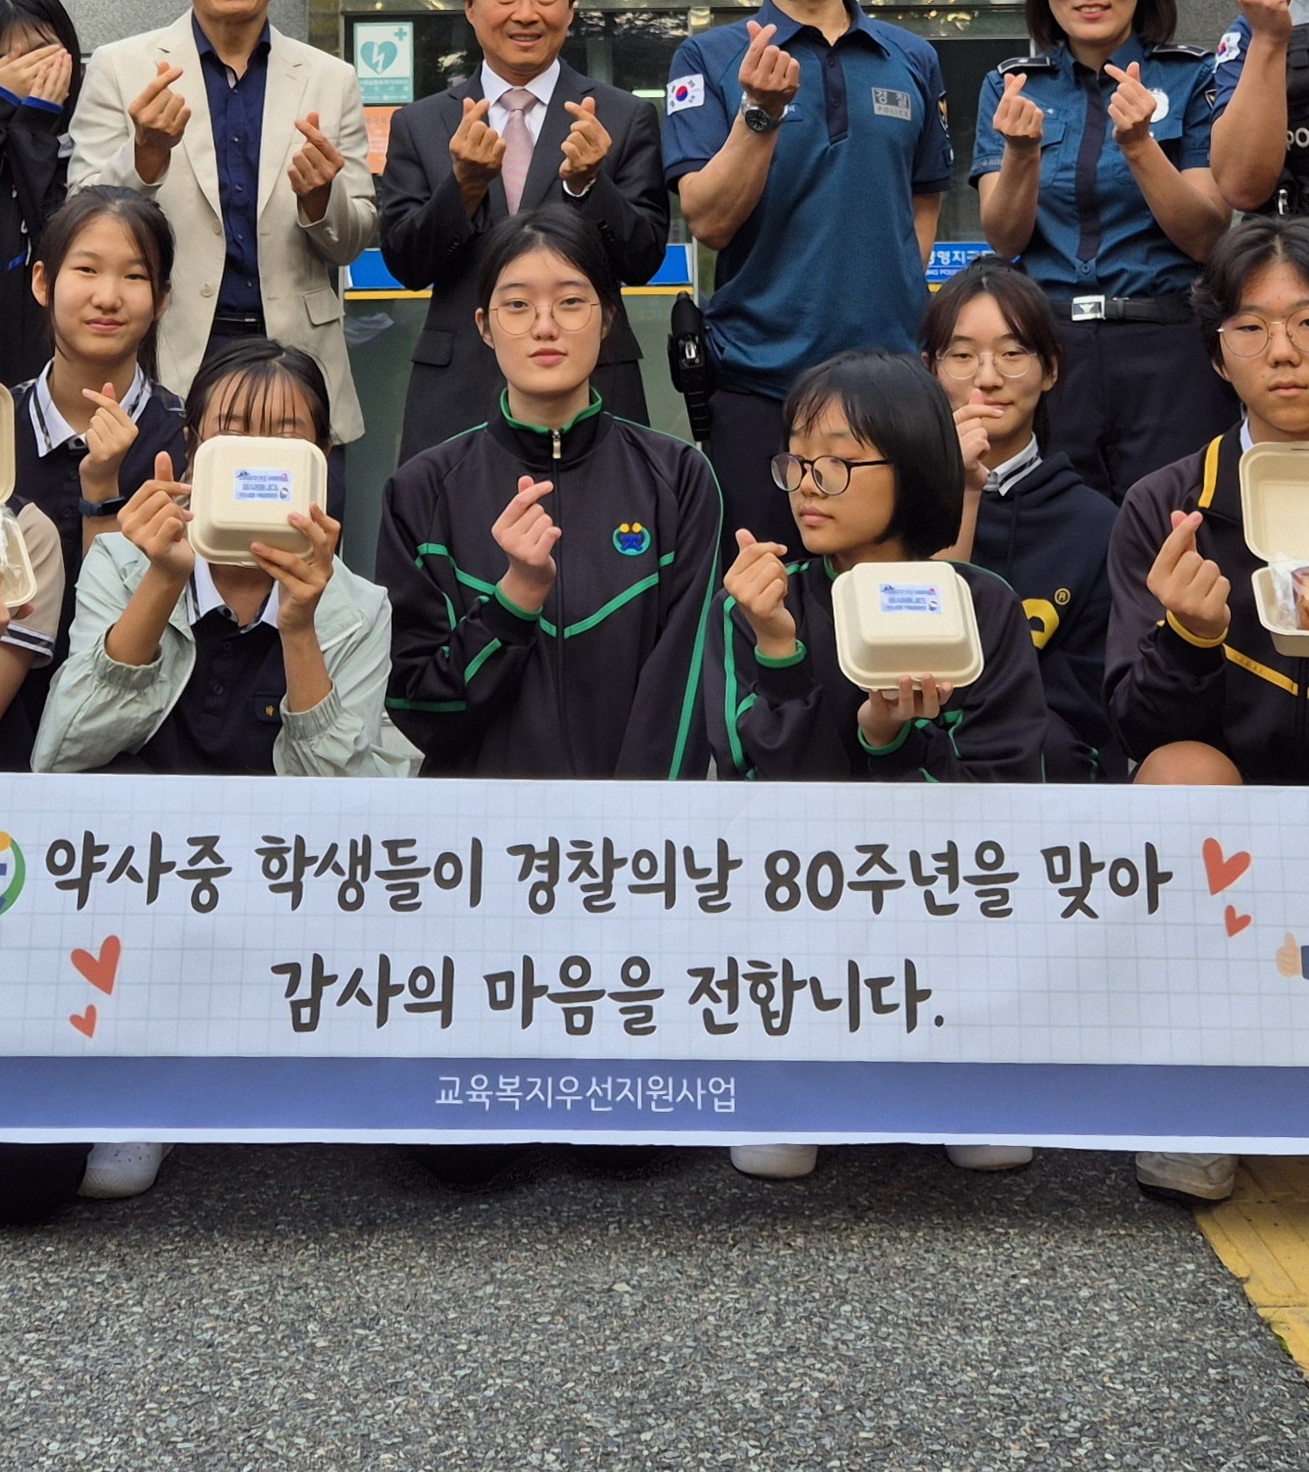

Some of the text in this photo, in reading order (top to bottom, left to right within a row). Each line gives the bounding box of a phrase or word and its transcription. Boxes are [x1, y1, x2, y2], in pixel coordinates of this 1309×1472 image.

[46, 830, 1174, 919] 약사중 학생들이 경찰의날 80주년을 맞아
[271, 953, 945, 1036] 감사의 마음을 전합니다.
[435, 1074, 736, 1113] 교육복지우선지원사업
